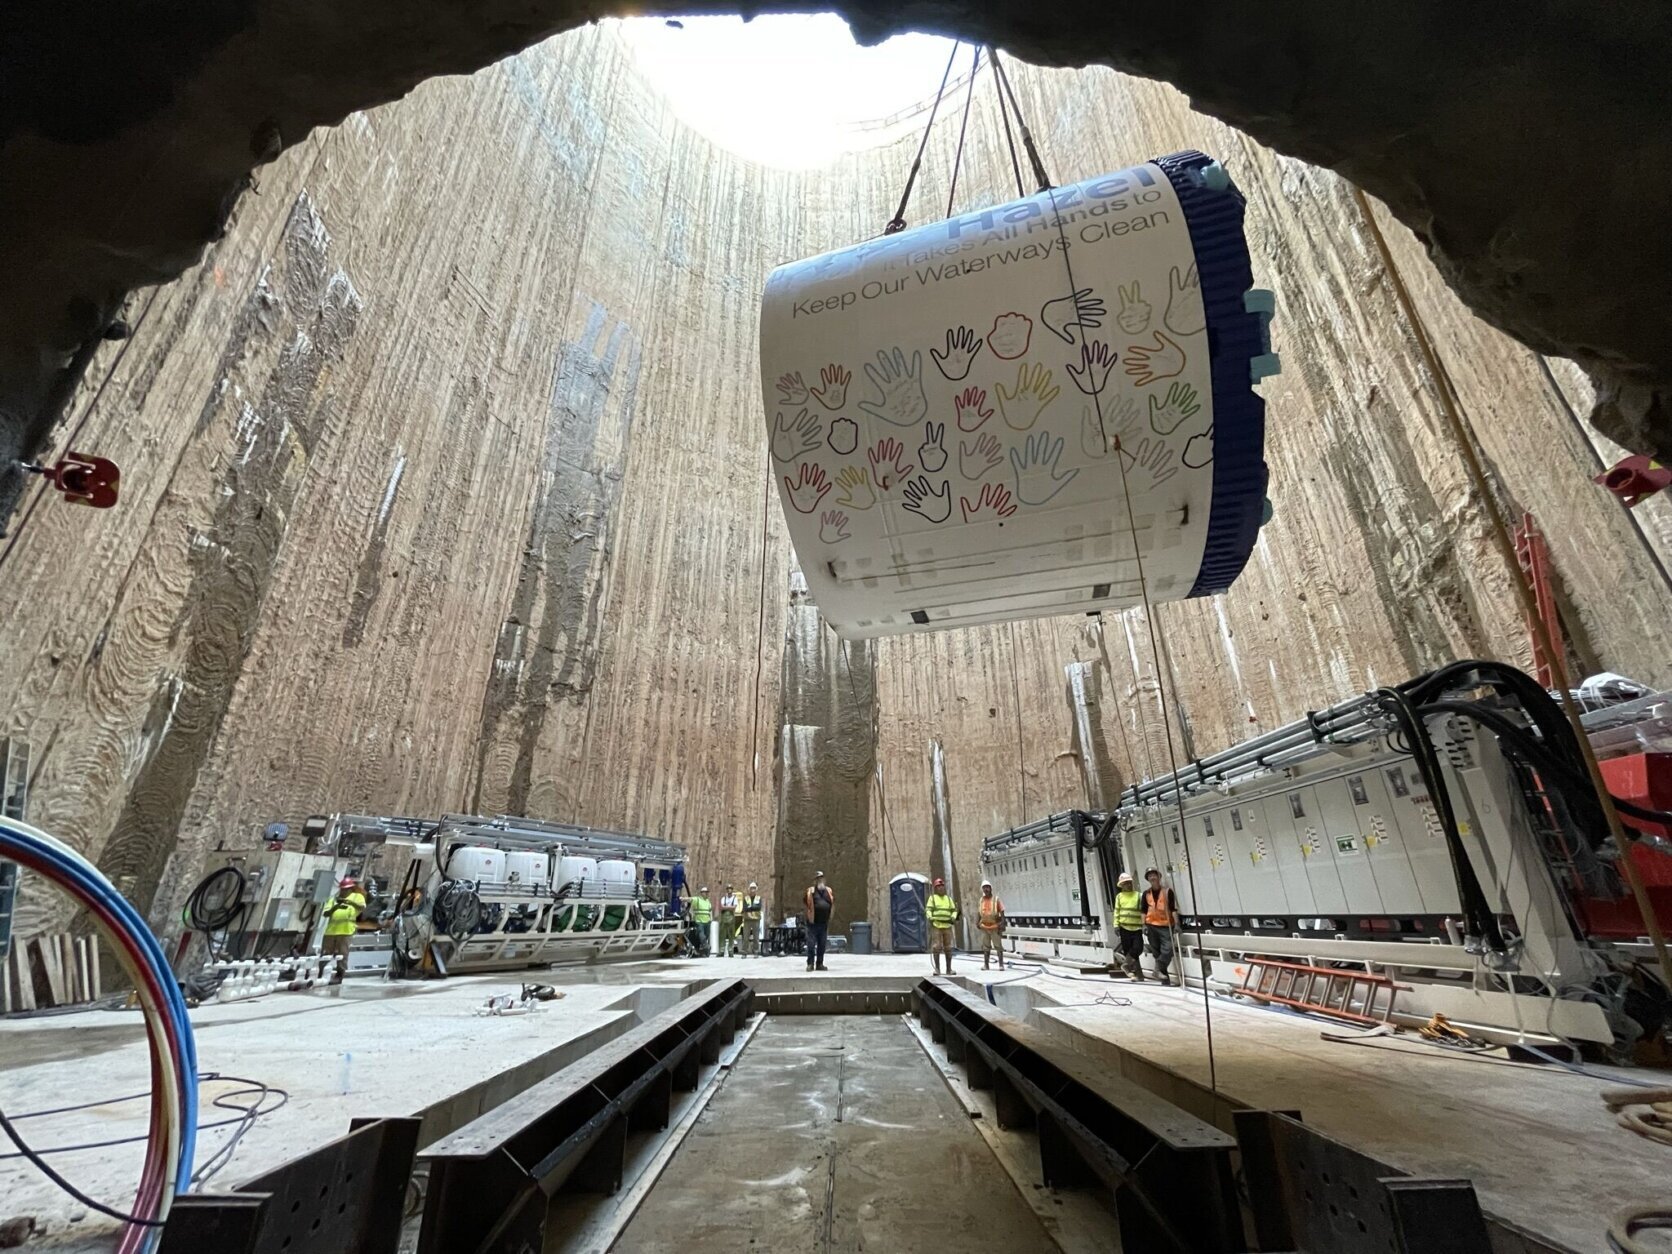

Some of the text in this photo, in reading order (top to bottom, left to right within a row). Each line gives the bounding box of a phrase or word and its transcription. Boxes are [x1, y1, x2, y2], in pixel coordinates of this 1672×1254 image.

[903, 239, 975, 267] Takes
[982, 222, 1018, 246] All
[1027, 197, 1129, 234] Hands
[1133, 189, 1162, 206] to
[948, 167, 1156, 239] Hazel
[792, 210, 1170, 319] Keep Our Waterways Clean
